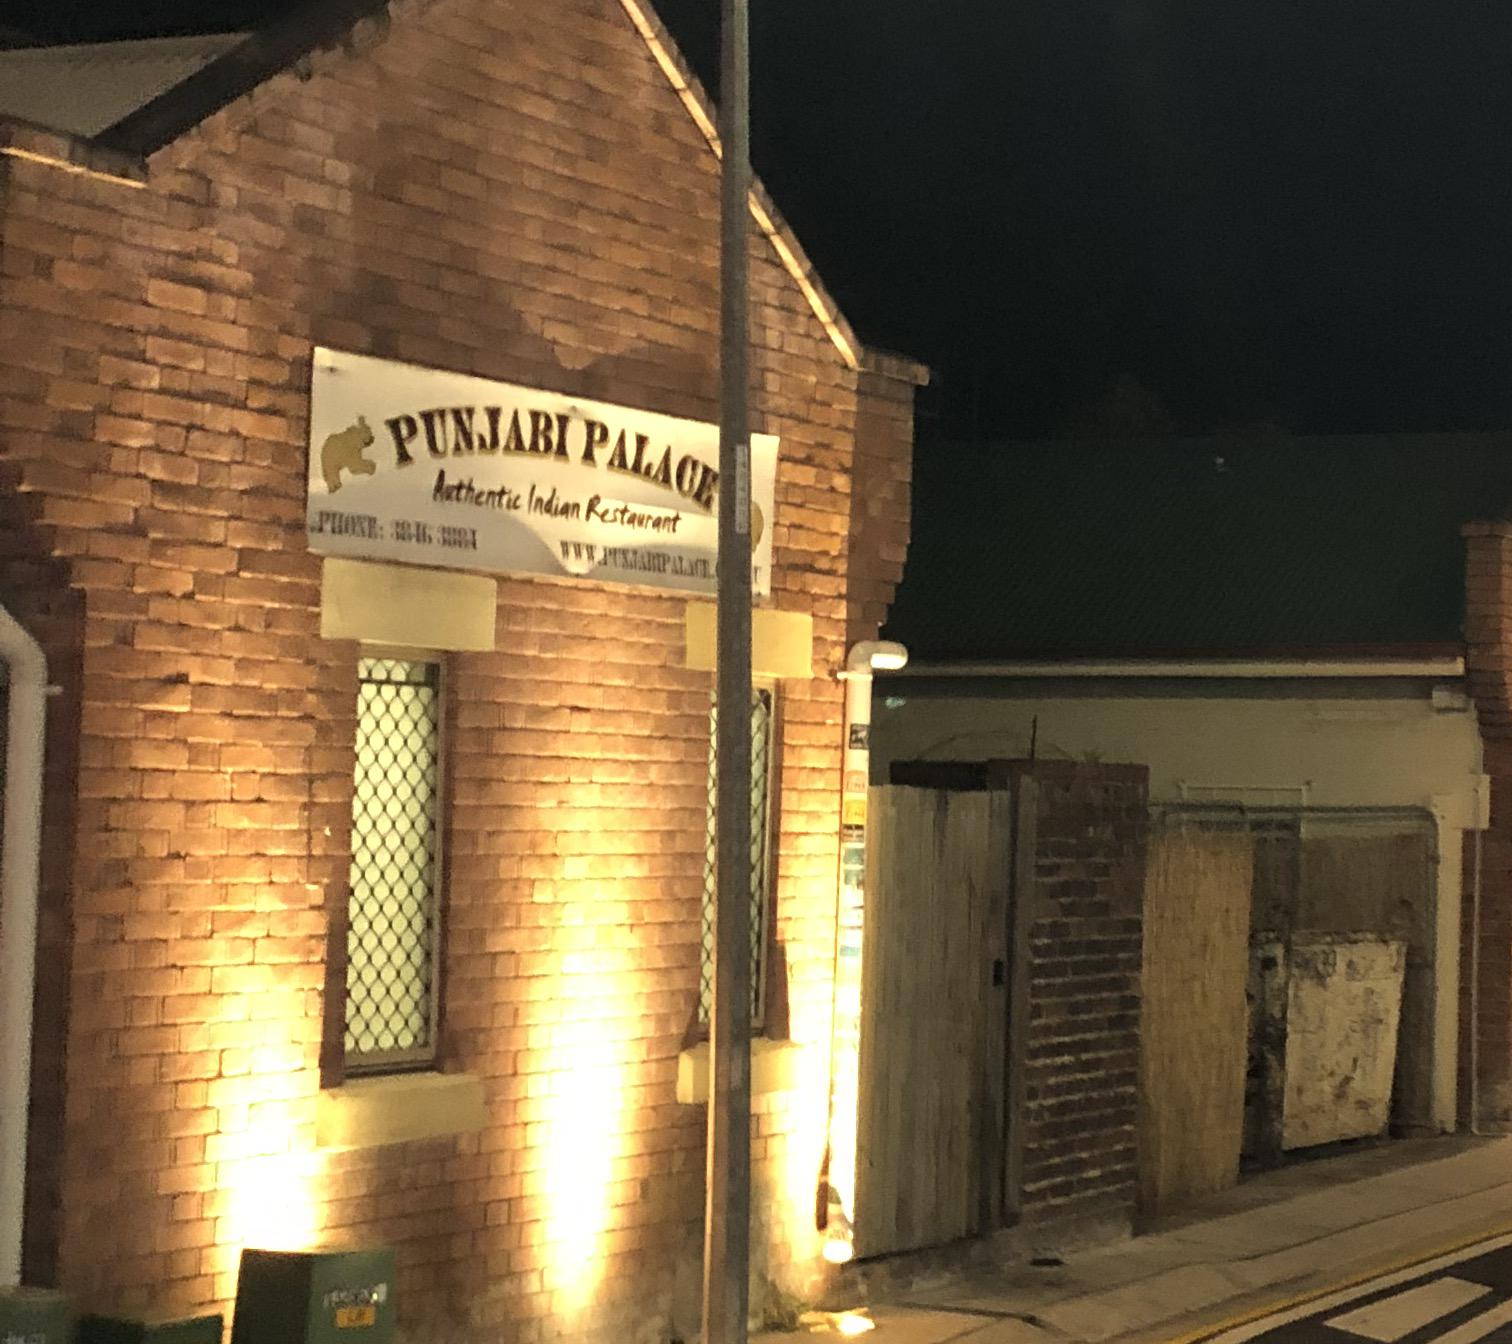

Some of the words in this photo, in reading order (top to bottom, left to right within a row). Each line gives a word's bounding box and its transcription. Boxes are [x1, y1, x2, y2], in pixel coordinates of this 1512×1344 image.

[385, 406, 571, 466] PUNJABI
[581, 418, 719, 512] PALACE
[433, 469, 521, 510] Authentic
[527, 483, 580, 521] Indian
[585, 494, 682, 533] Restaurant
